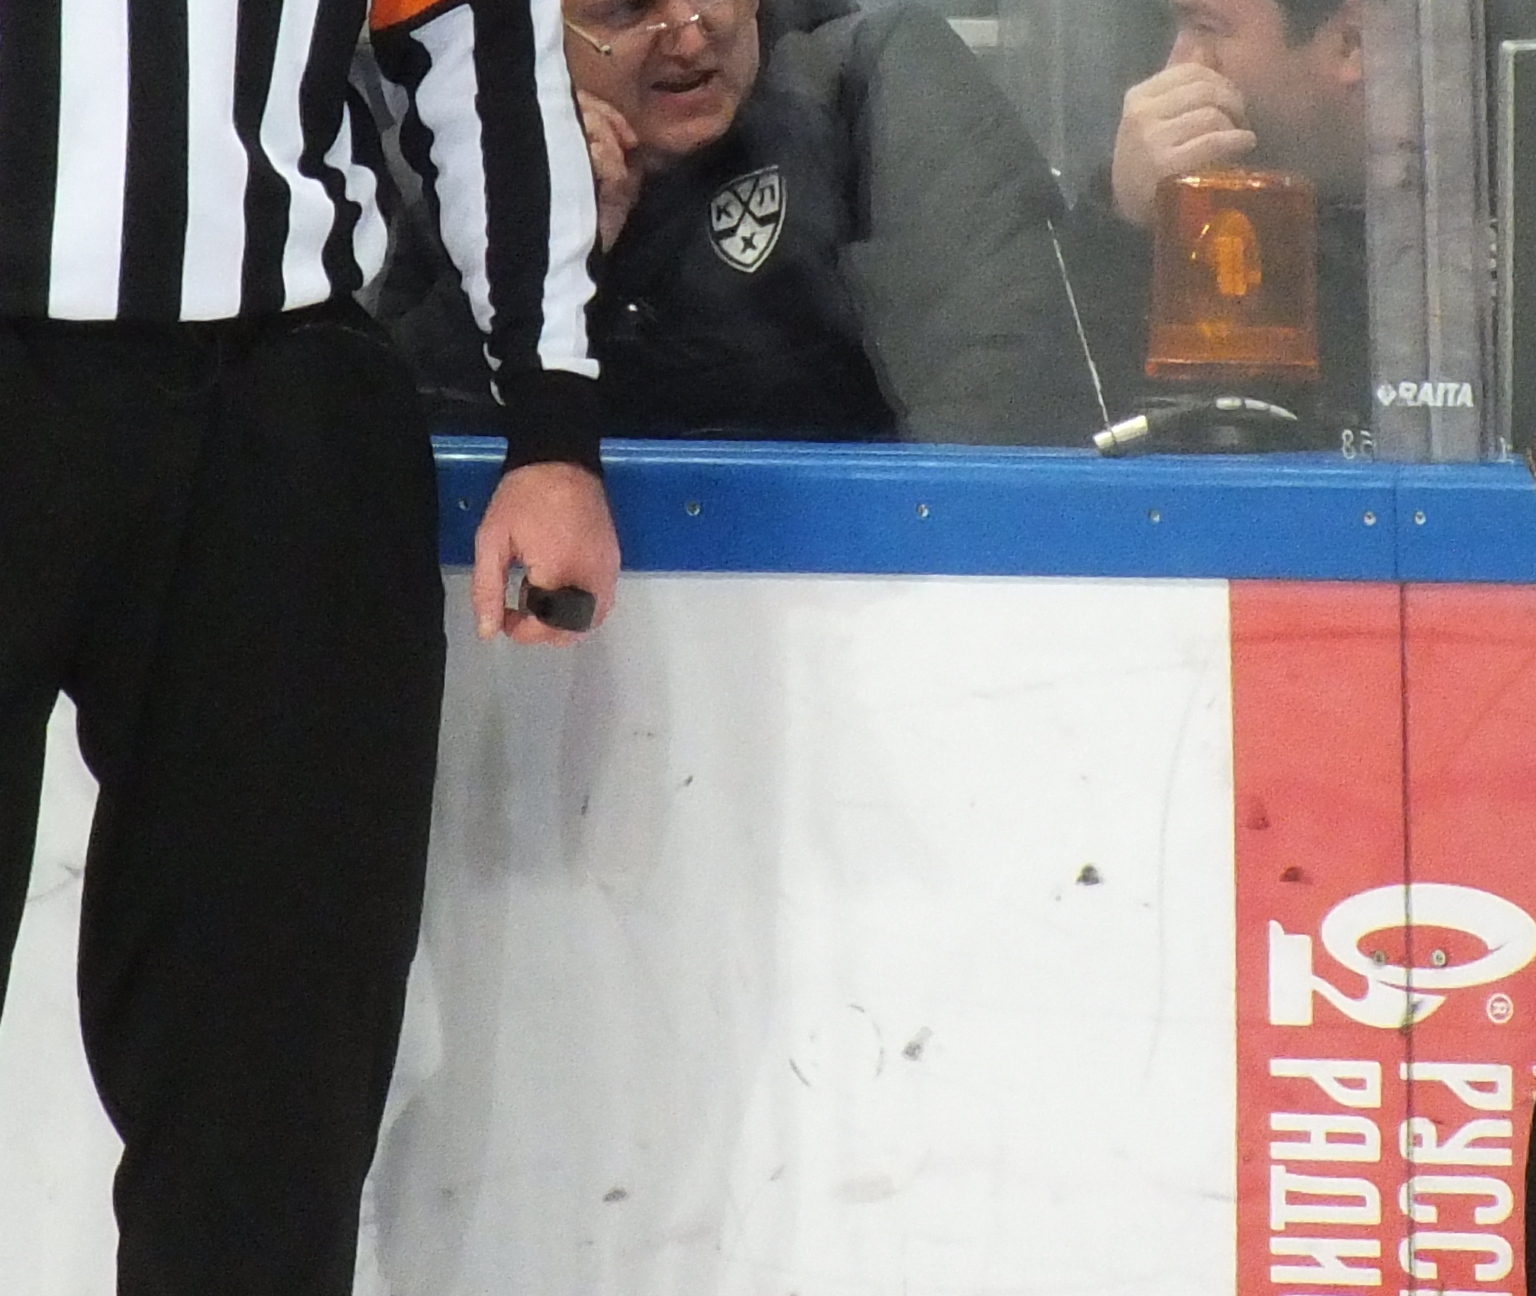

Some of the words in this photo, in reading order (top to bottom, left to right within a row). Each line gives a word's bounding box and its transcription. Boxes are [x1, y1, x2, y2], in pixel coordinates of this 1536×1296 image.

[1398, 380, 1475, 408] RAITA
[1268, 1058, 1383, 1296] РАДИ
[1398, 1061, 1514, 1296] РУСС
